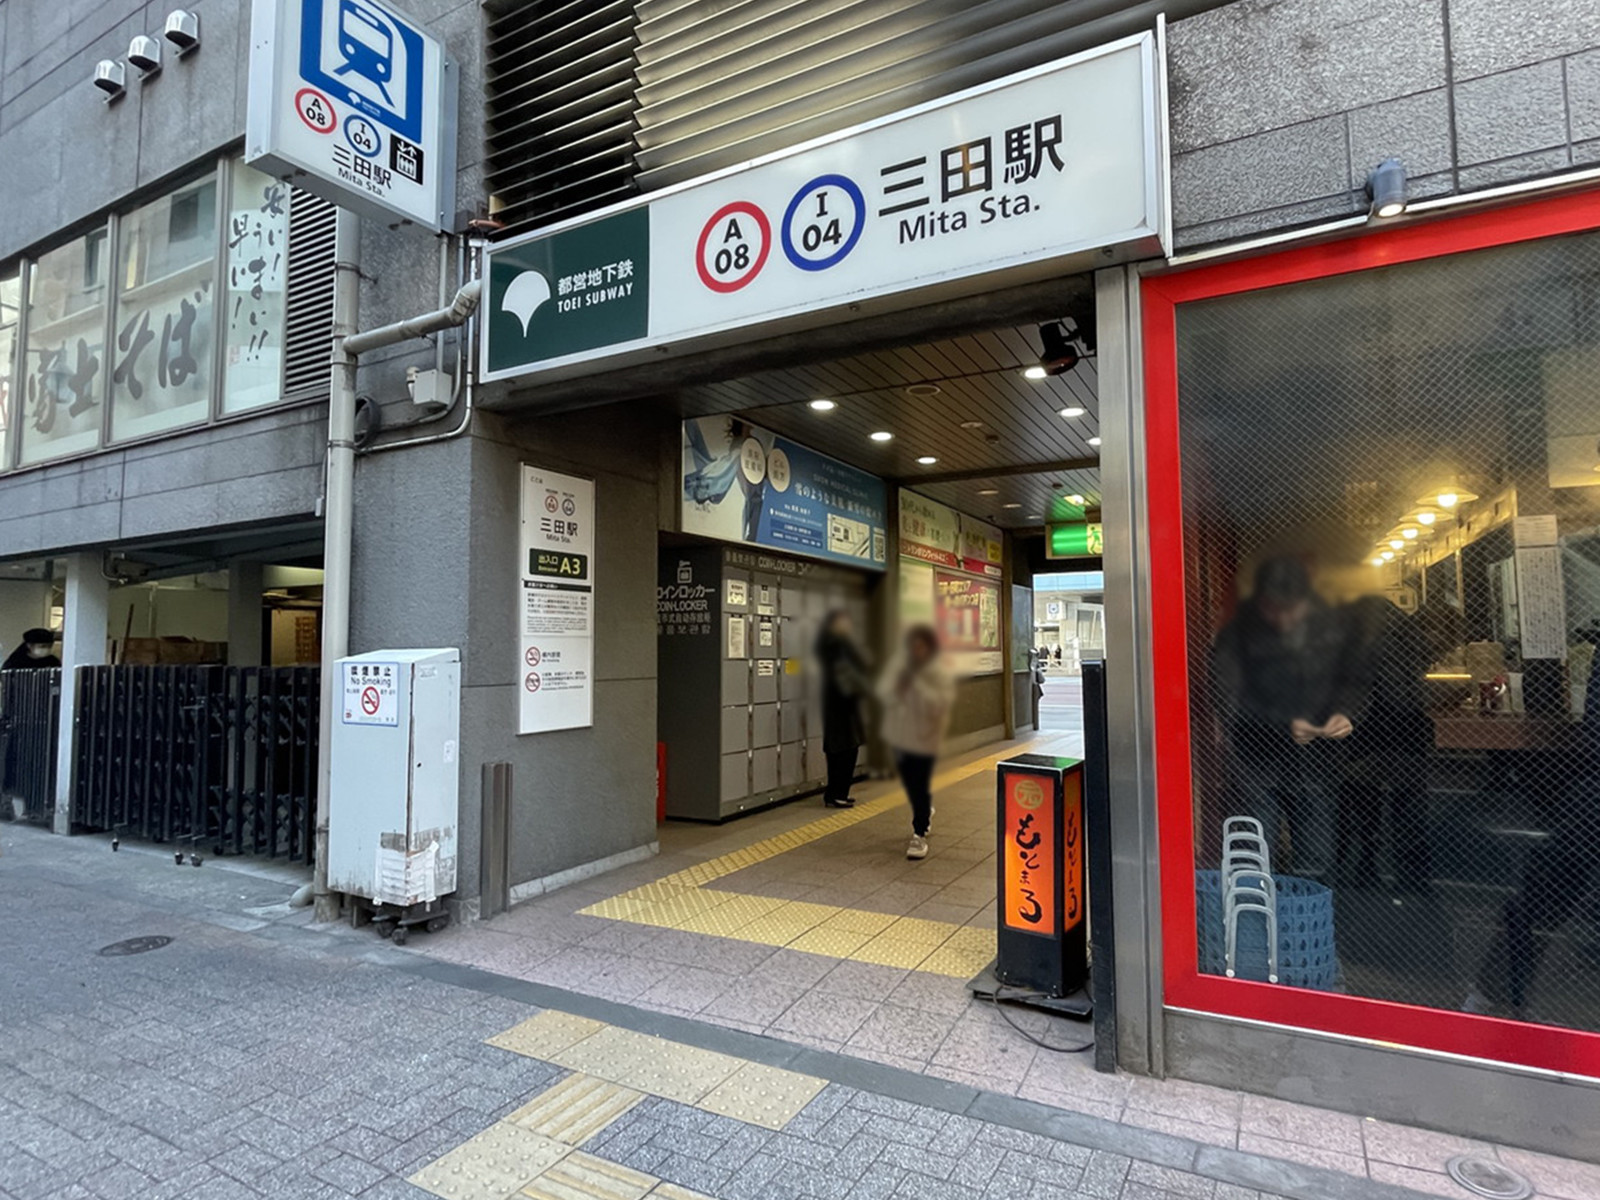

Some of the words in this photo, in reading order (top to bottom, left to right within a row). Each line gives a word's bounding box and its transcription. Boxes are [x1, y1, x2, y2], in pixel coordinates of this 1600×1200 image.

[306, 107, 326, 126] 08
[311, 98, 322, 111] A
[353, 132, 372, 150] 04
[360, 123, 367, 135] I
[332, 143, 392, 190] 三田駅
[878, 114, 1066, 217] 三田駅
[338, 167, 364, 187] Mita
[365, 181, 386, 198] Sta.
[816, 191, 828, 218] I
[723, 218, 742, 244] A
[899, 211, 967, 244] Mita
[979, 194, 1041, 225] Sta.
[802, 218, 843, 252] 04
[715, 243, 750, 275] 08
[557, 258, 635, 297] 都営地下鉄
[557, 298, 582, 314] TOEI
[585, 281, 635, 307] SUBWAY
[540, 517, 578, 537] 三田駅
[559, 557, 581, 575] A3
[351, 677, 360, 685] No
[362, 676, 391, 688] Smoking
